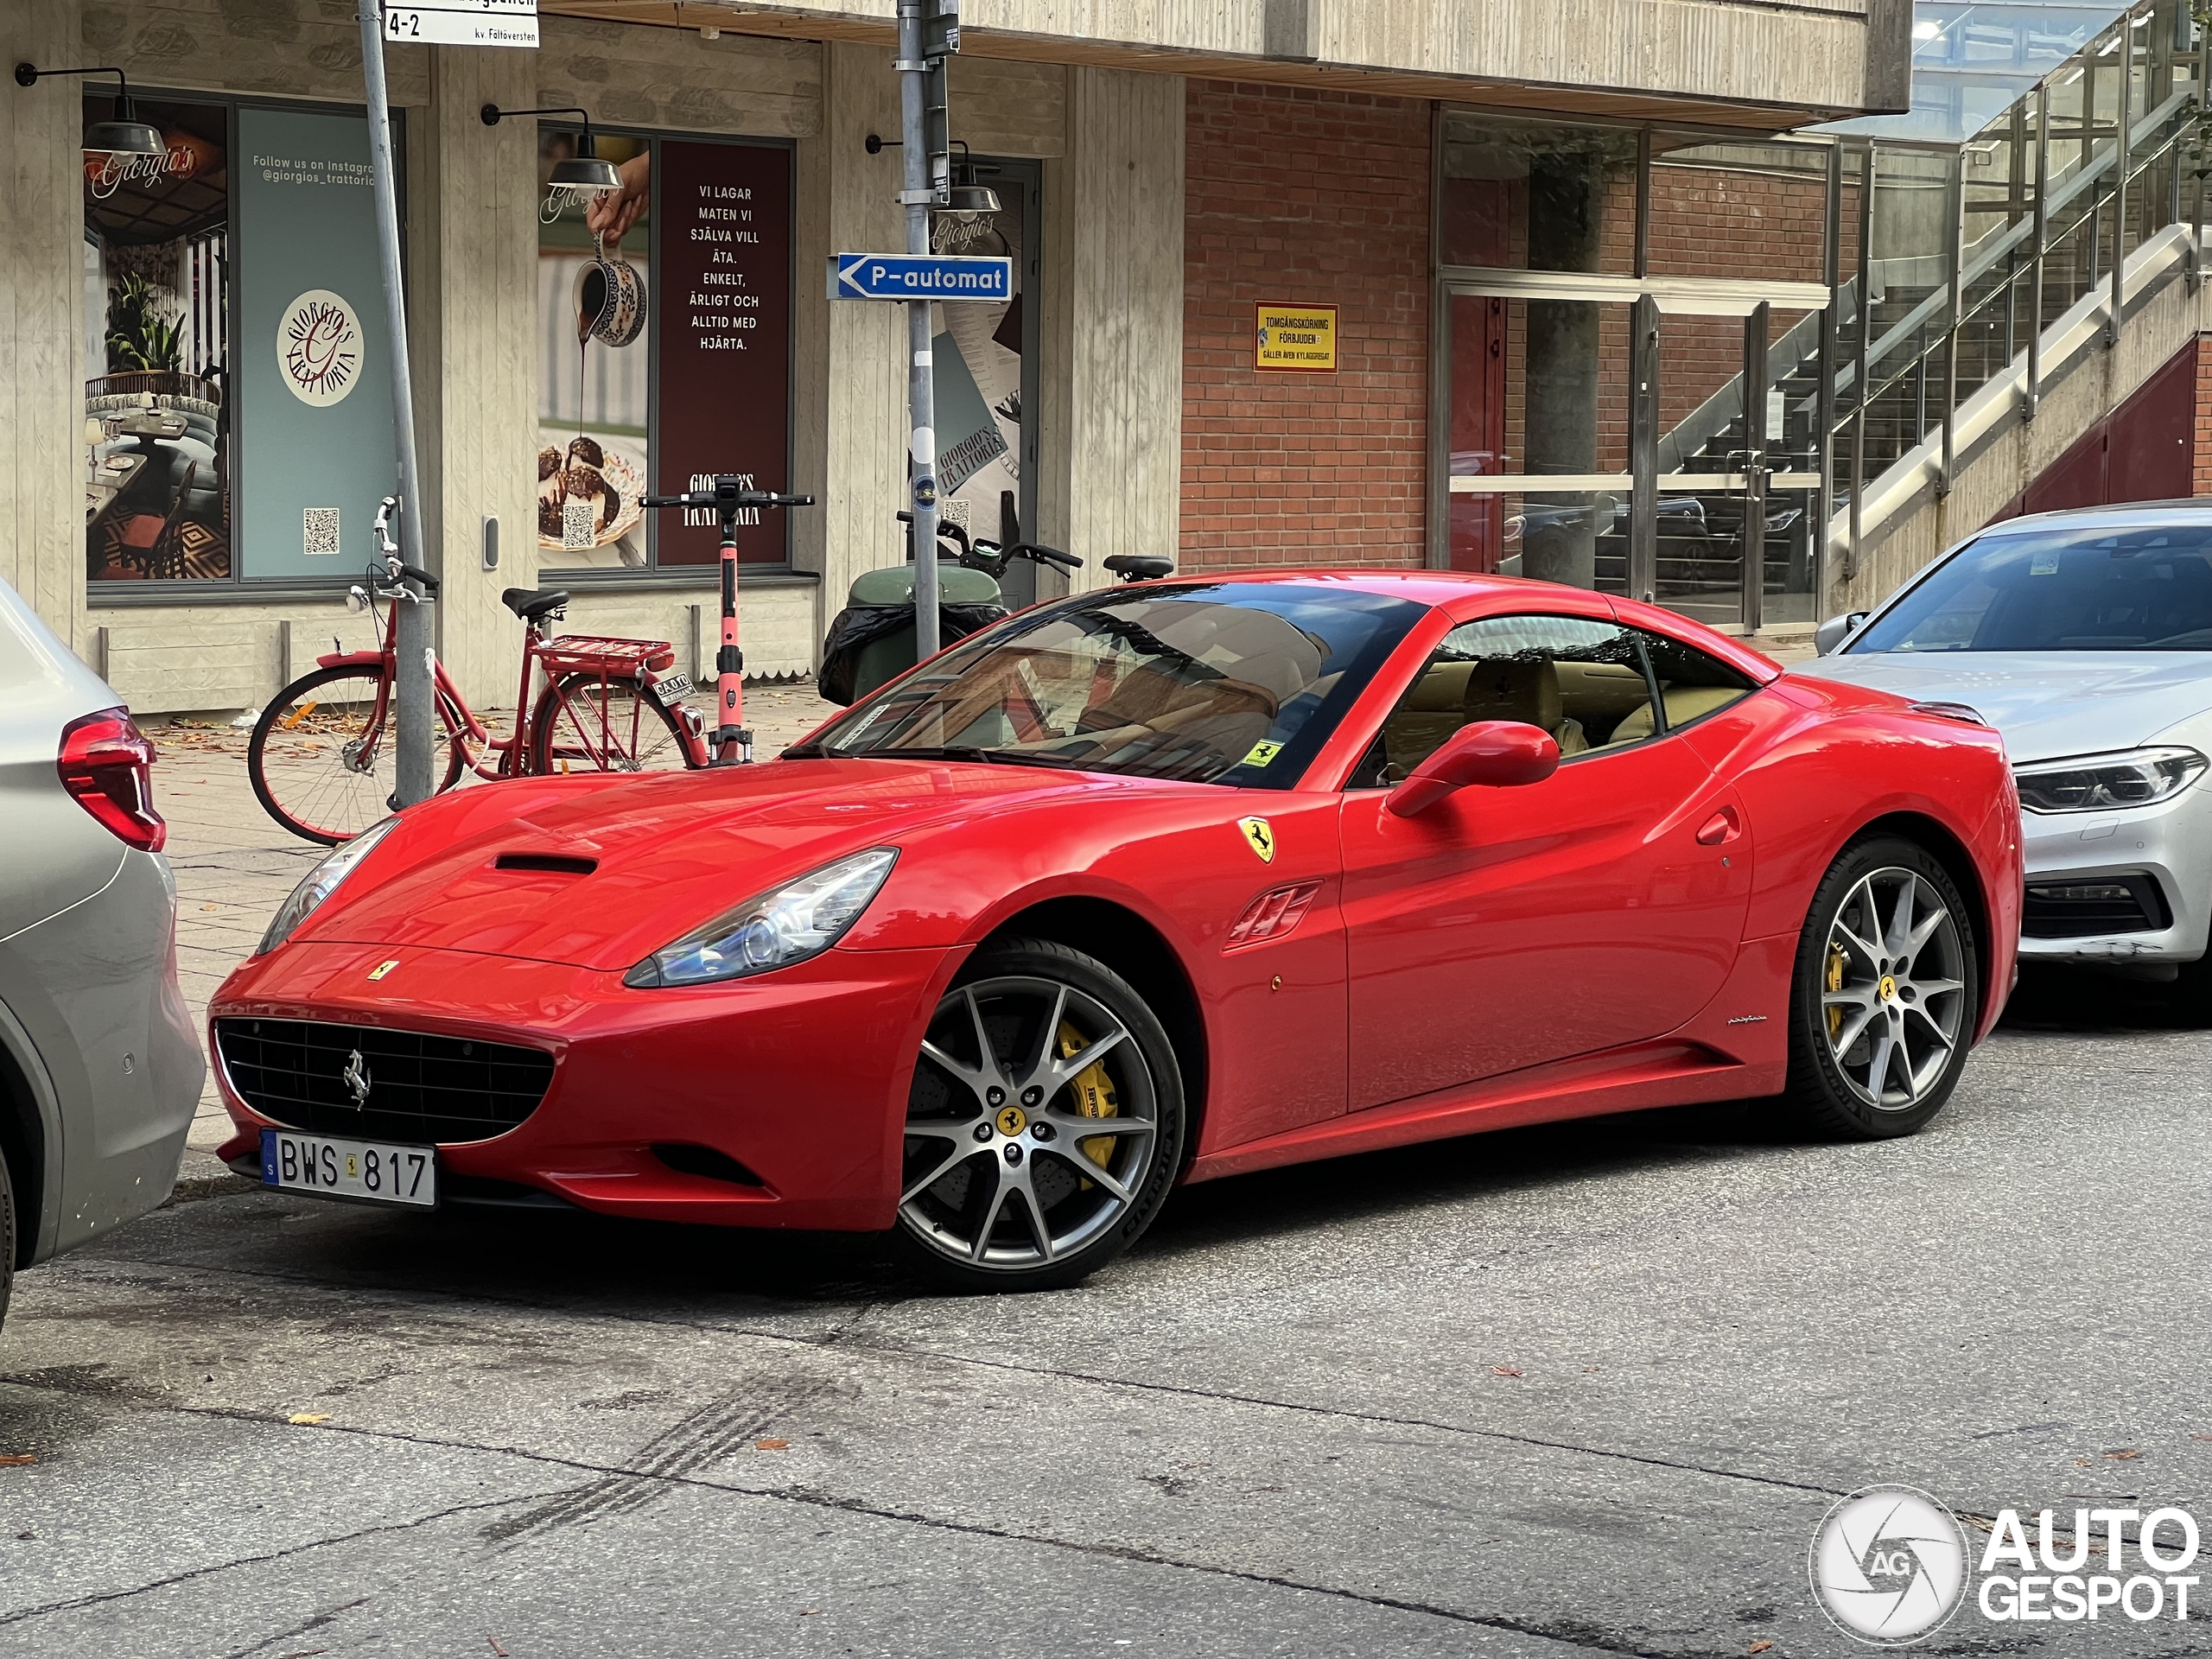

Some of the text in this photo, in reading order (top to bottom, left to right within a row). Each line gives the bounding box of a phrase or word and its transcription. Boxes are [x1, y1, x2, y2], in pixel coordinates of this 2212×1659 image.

[390, 13, 420, 36] 4-2
[489, 29, 536, 41] Fältöversten
[253, 155, 290, 168] Follow
[311, 162, 324, 170] on
[328, 161, 374, 175] Instagra
[699, 185, 752, 200] VI LAGAR
[699, 207, 752, 221] MATEN VI
[690, 226, 760, 243] SJÄLVA VILL
[713, 248, 737, 264] ÄTA.
[703, 272, 746, 288] ENKELT,
[872, 266, 1001, 289] P-automat
[690, 290, 759, 307] ÄRLIGT OCH
[691, 315, 757, 328] ALLTID MED
[1266, 315, 1329, 329] TOMGÅNGSKÖRNING
[701, 334, 747, 350] HJÄRTA.
[1279, 331, 1316, 344] FÖRBJUDEN
[286, 348, 356, 395] TRATTORIA
[940, 426, 992, 469] GIORGIO'S
[938, 437, 1003, 489] TRATTORIA
[267, 1164, 274, 1176] S
[281, 1139, 426, 1197] BWS 817
